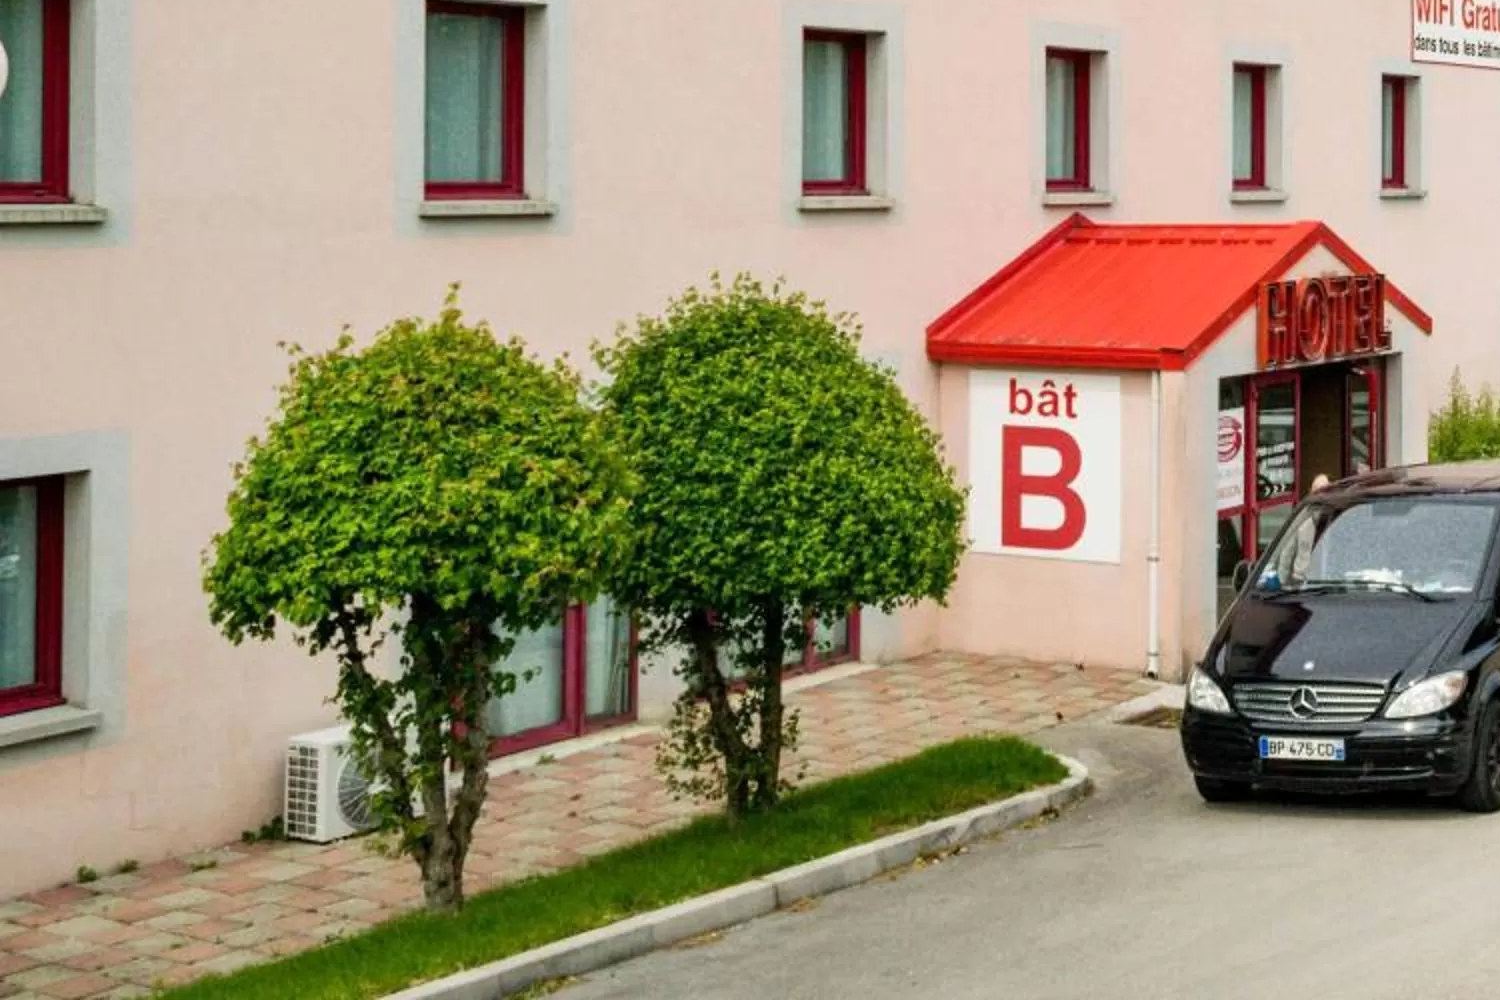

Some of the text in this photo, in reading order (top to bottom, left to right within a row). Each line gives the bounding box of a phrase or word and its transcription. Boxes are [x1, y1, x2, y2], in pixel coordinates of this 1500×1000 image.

[1415, 33, 1437, 52] dans
[1439, 37, 1459, 54] tous
[1463, 39, 1476, 56] les
[1256, 274, 1392, 371] HOTEL
[1009, 377, 1078, 420] bât
[1001, 424, 1087, 552] B
